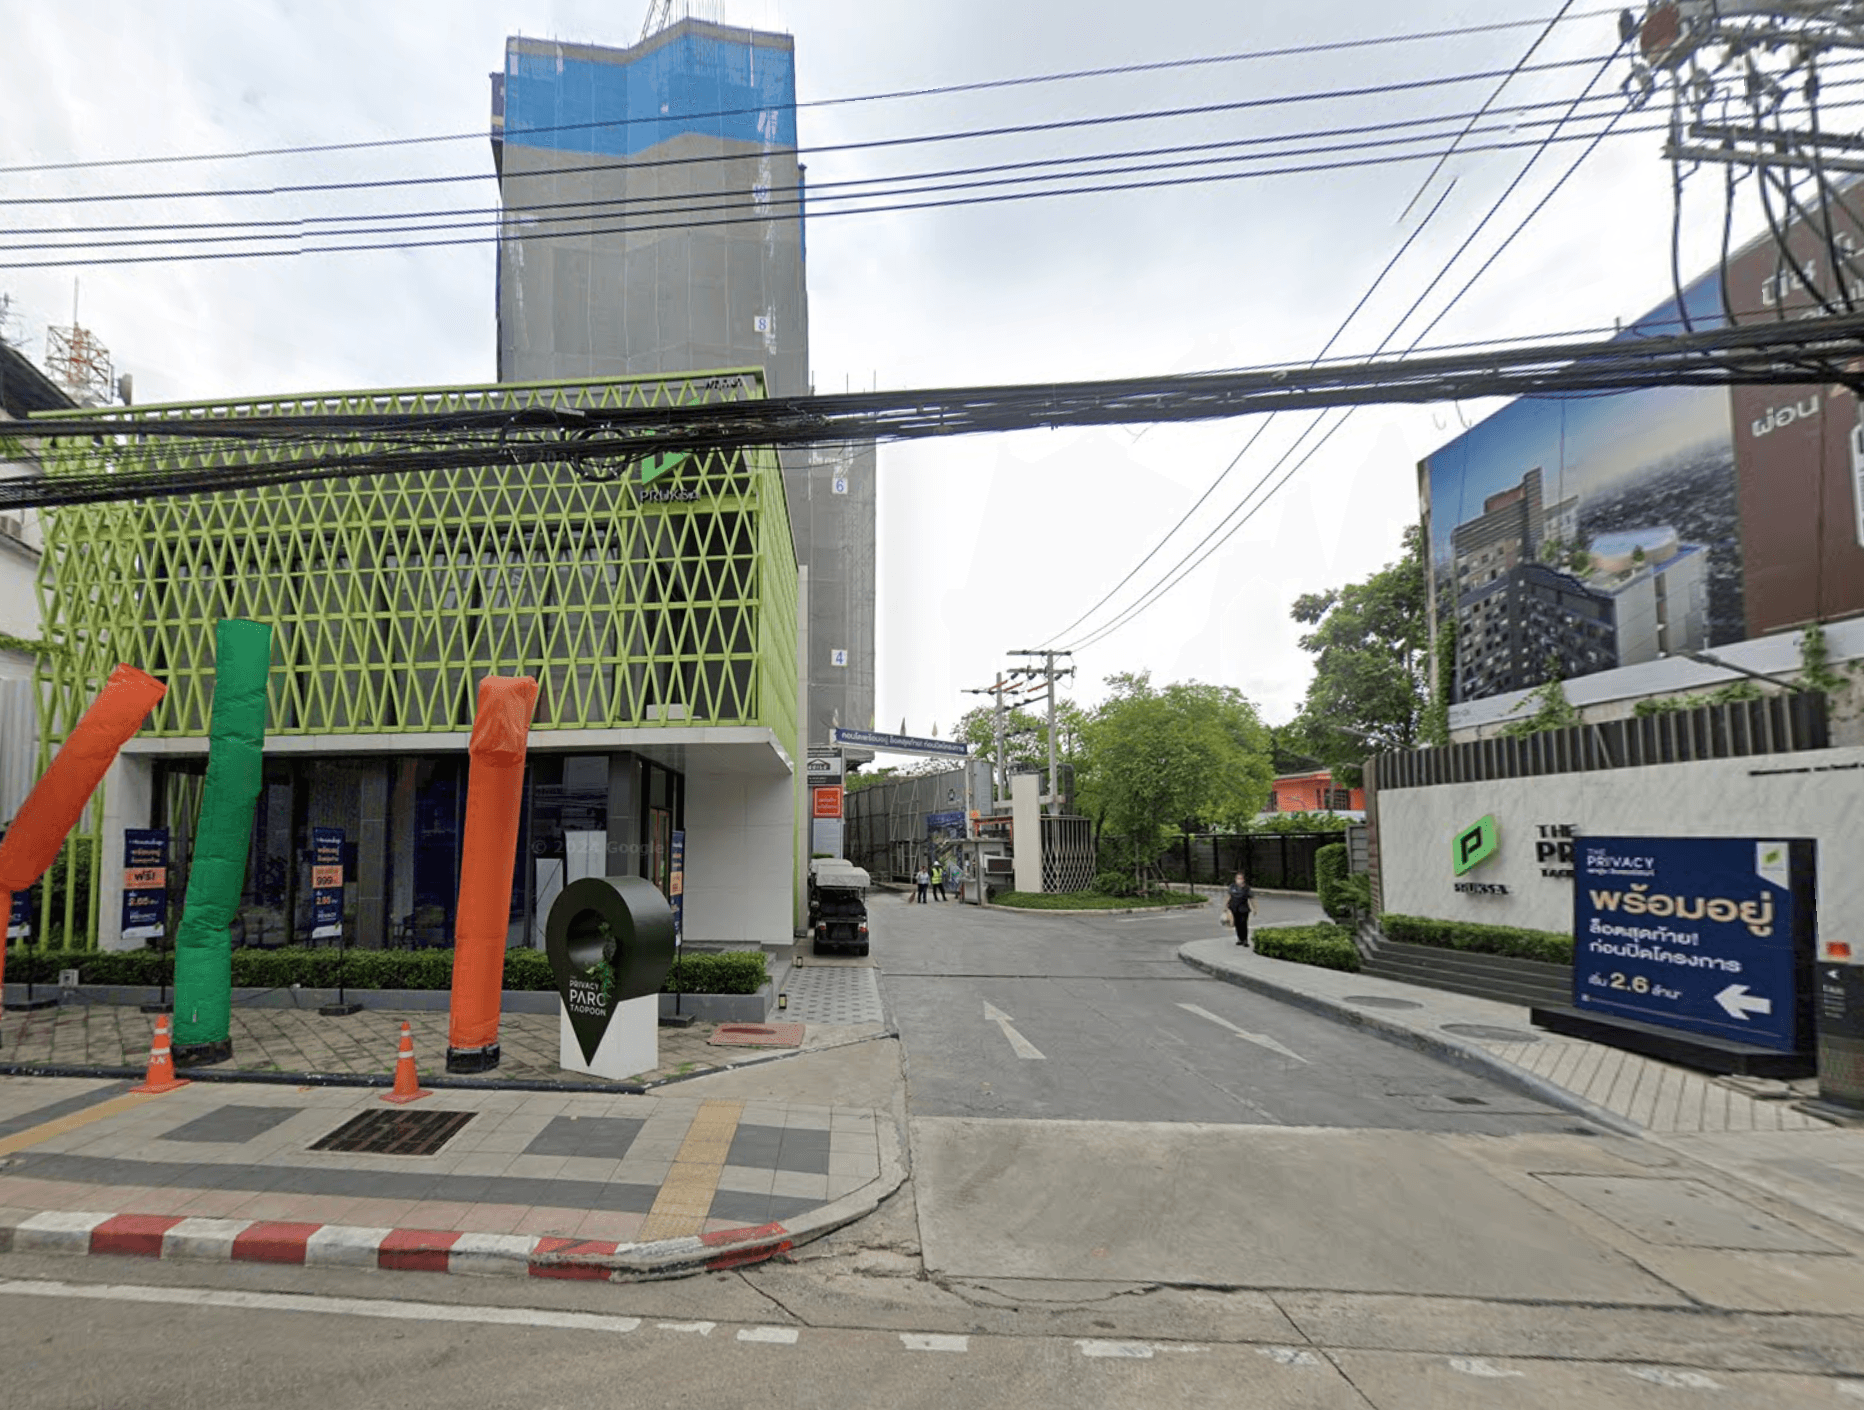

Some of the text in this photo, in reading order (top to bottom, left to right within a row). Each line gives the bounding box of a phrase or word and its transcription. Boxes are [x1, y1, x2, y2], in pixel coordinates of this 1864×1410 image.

[758, 317, 767, 331] 8
[1752, 395, 1820, 437] ผ่อน
[835, 480, 844, 493] 6
[835, 651, 844, 665] 4
[1535, 823, 1577, 838] THE
[1586, 855, 1655, 869] PRIVACY
[1589, 883, 1774, 937] พร้อมอยู่
[1589, 938, 1743, 973] ก่อนปิดโครงการ
[569, 980, 600, 990] PRIVACY
[1610, 971, 1650, 994] 2.6
[570, 989, 606, 1007] PARC
